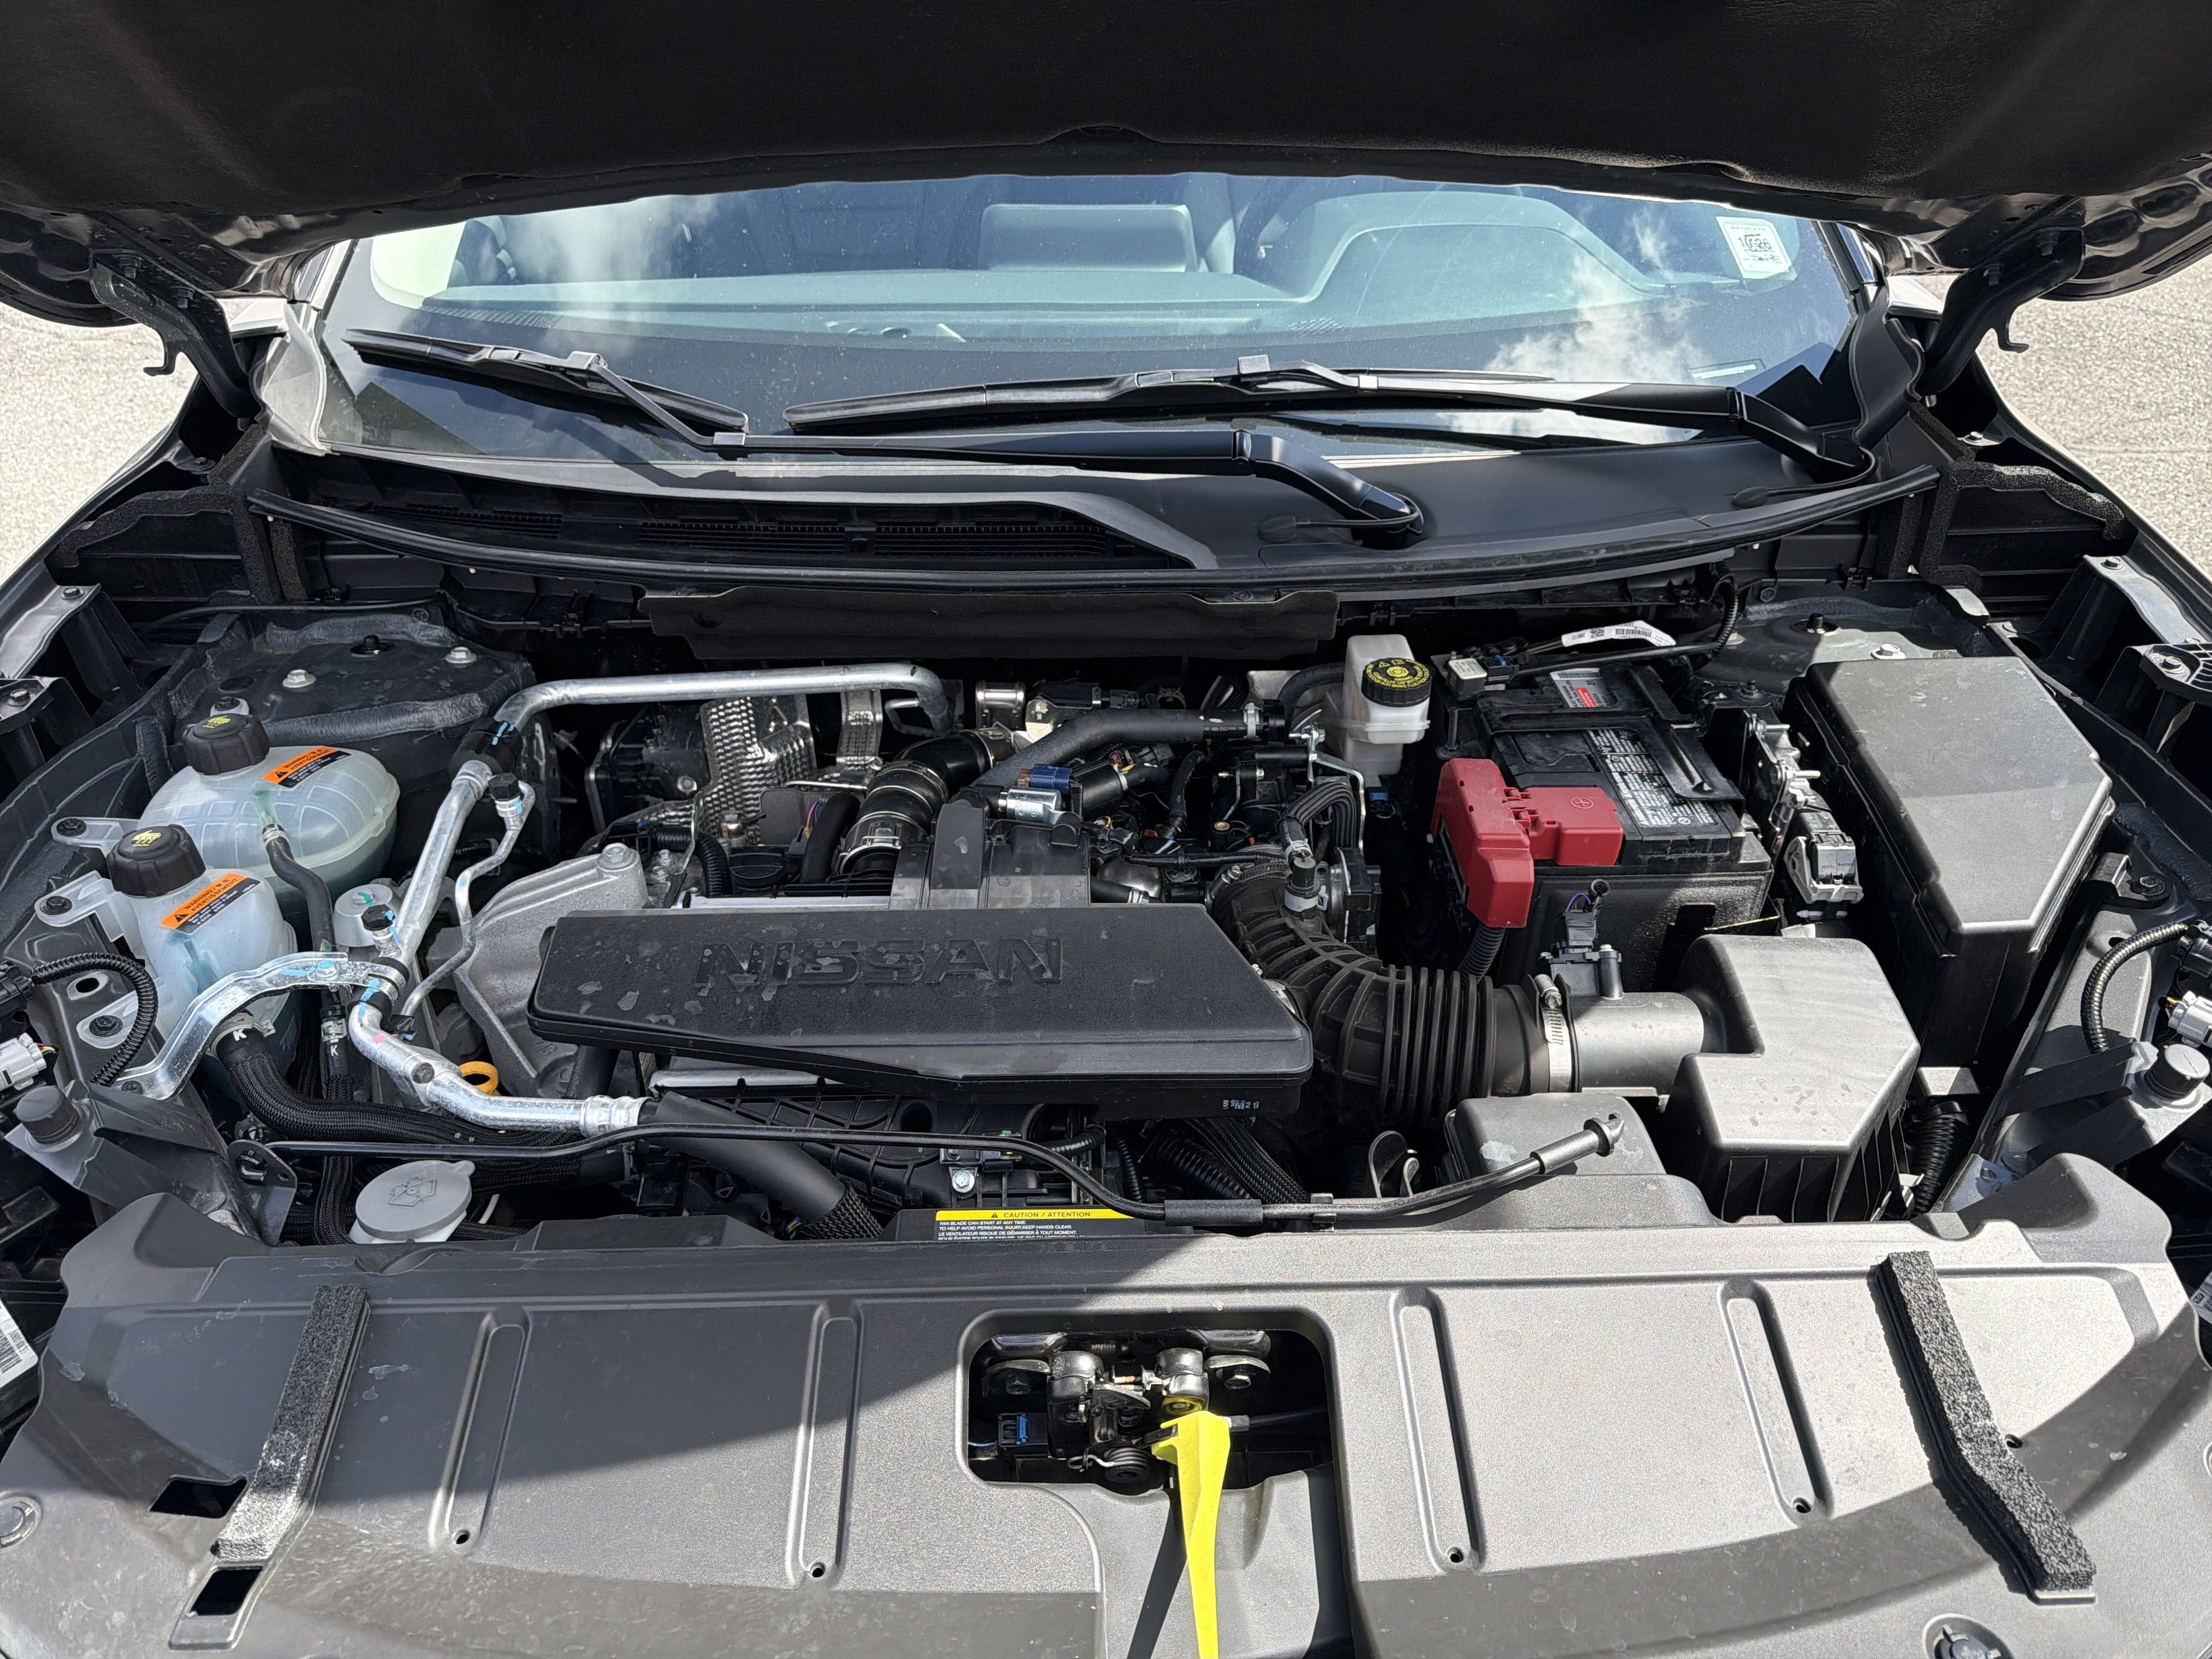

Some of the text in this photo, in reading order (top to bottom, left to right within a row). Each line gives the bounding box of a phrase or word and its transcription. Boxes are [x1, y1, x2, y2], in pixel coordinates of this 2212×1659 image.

[184, 890, 213, 910] WARNING
[191, 879, 239, 912] AVERTISSEMENT
[695, 938, 1063, 986] NISSAN
[233, 1029, 247, 1041] K
[331, 1045, 338, 1057] K
